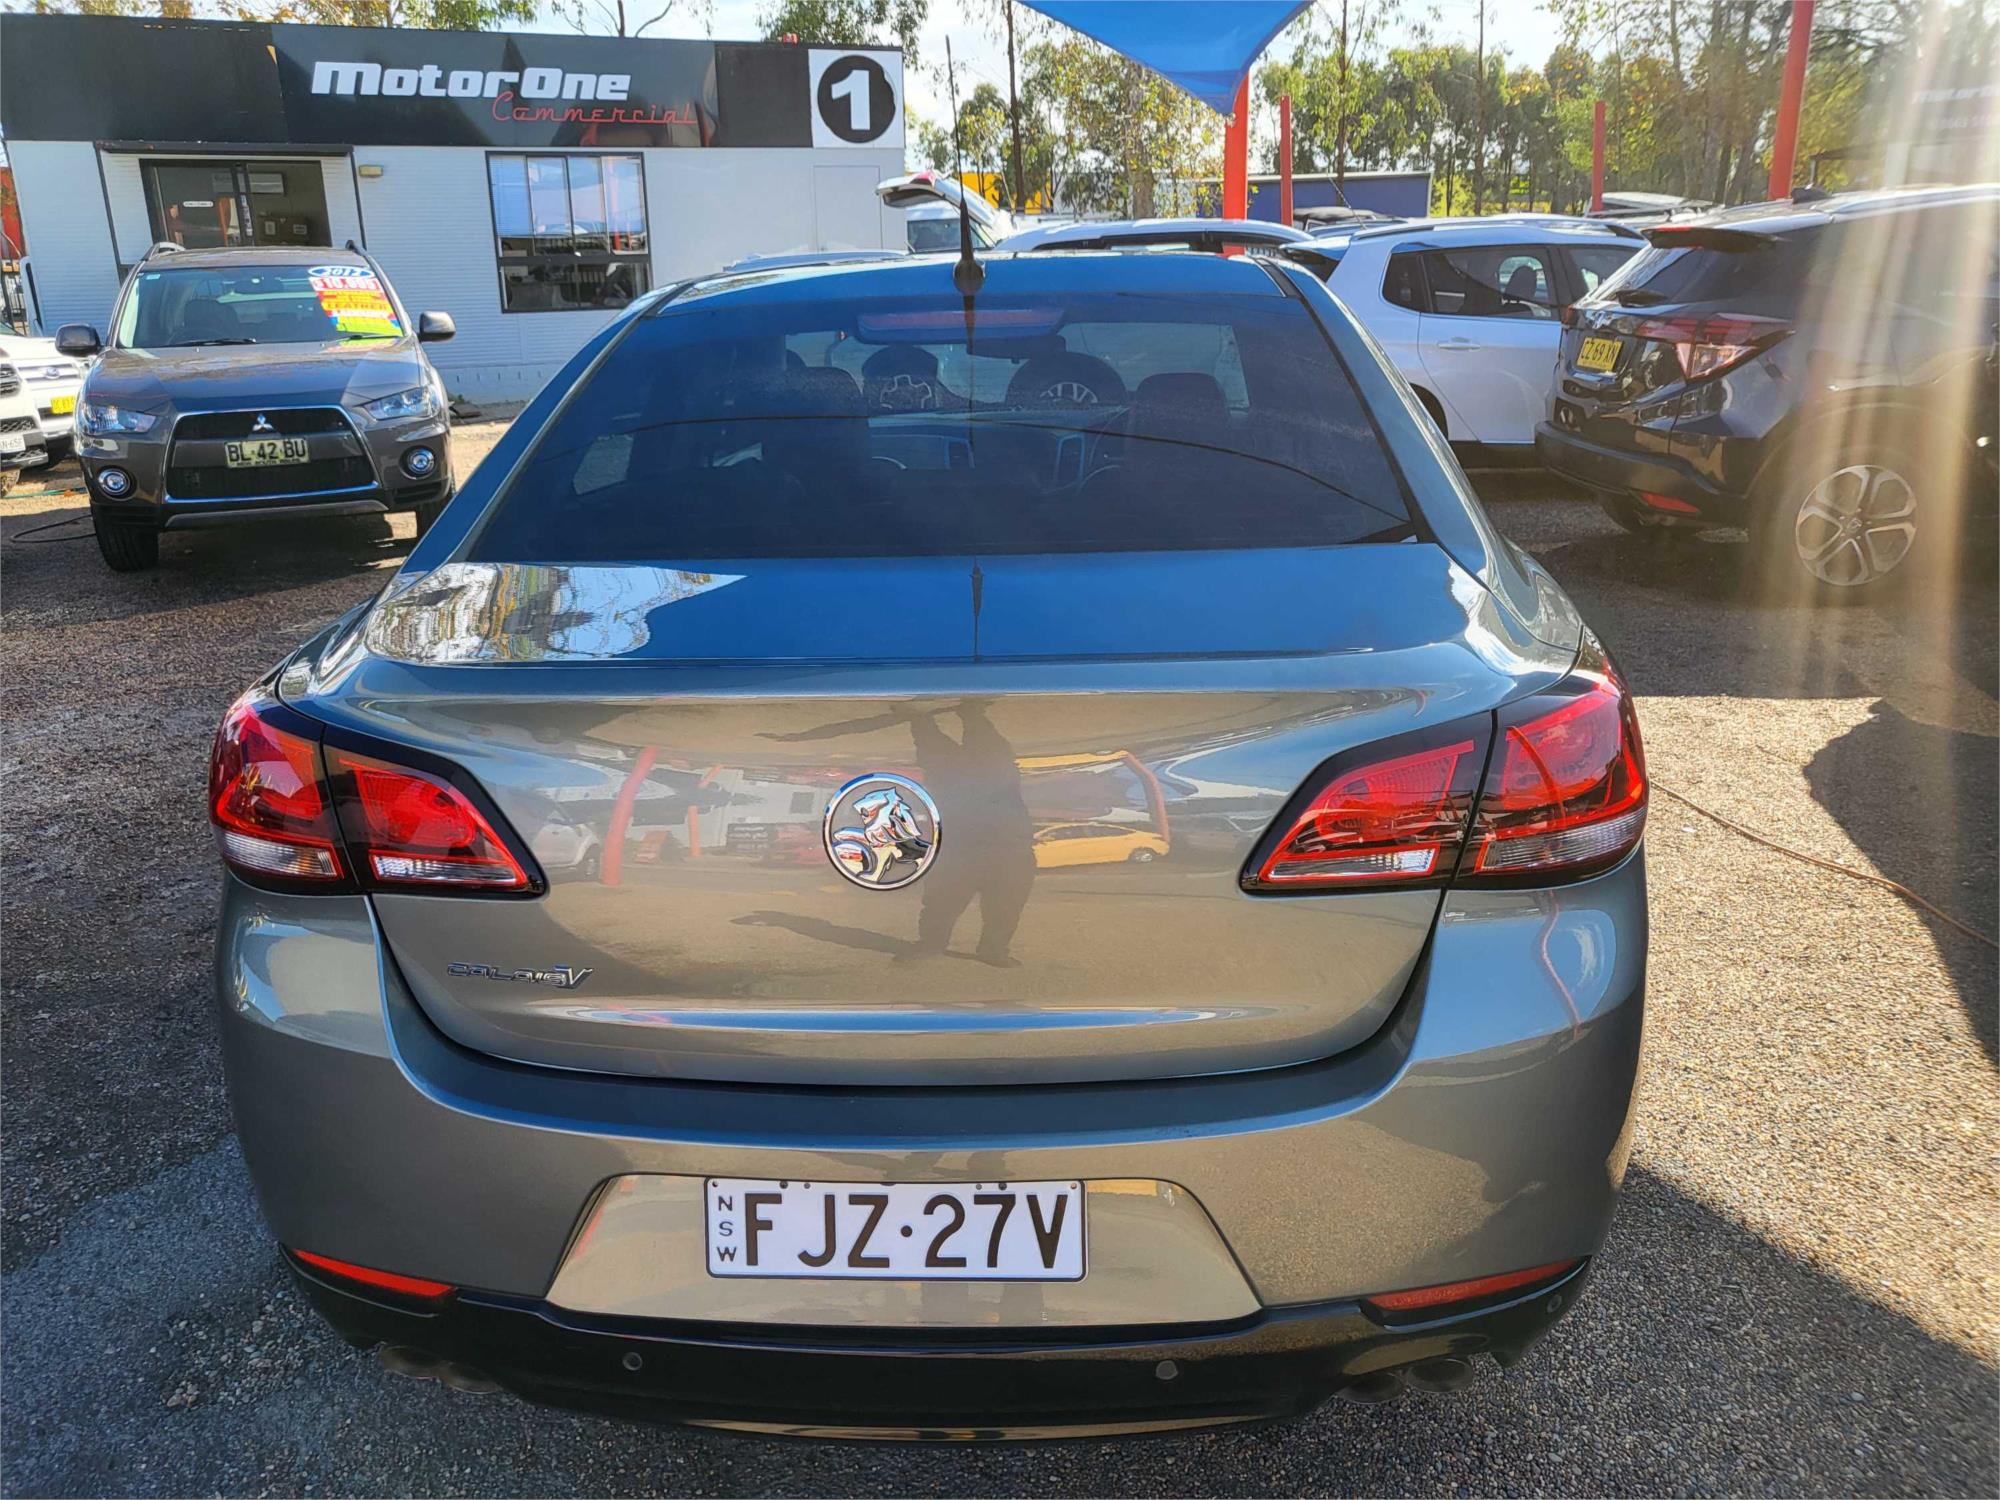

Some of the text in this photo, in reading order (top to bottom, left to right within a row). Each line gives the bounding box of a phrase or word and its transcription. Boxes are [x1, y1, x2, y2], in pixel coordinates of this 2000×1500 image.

[311, 61, 631, 100] MotorOne
[492, 91, 698, 125] Commercial
[830, 69, 871, 130] 1
[327, 302, 389, 312] LEATHER
